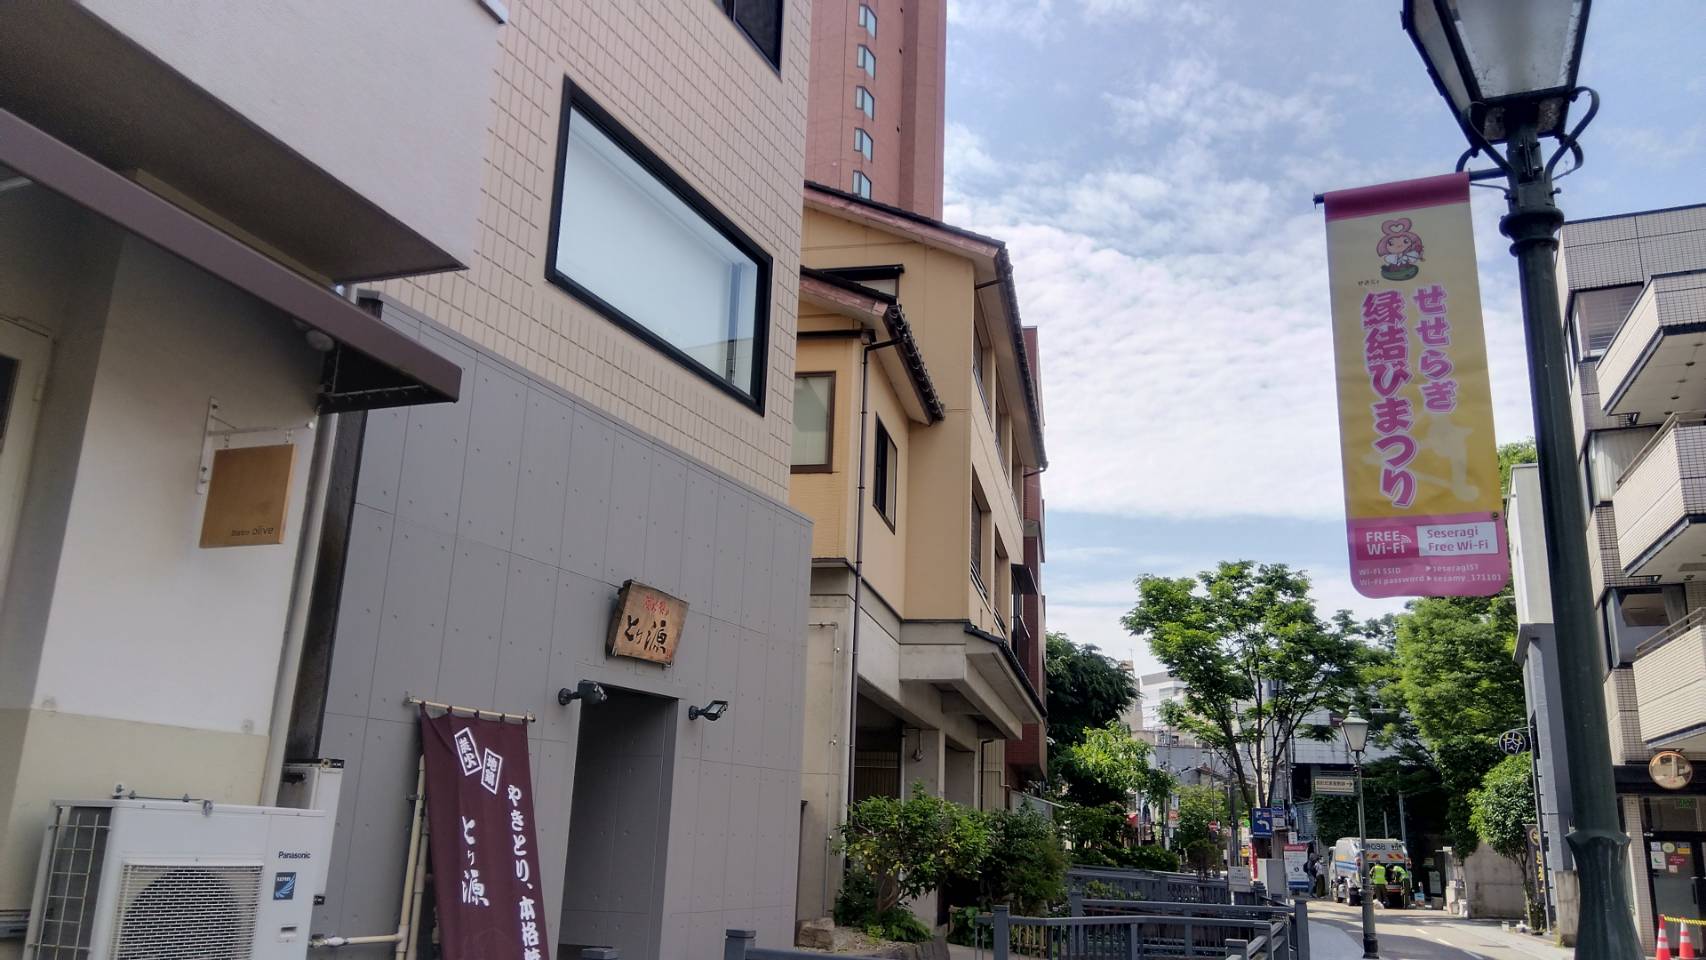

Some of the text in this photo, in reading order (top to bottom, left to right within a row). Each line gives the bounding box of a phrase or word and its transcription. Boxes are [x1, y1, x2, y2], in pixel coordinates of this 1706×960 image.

[1413, 284, 1458, 412] せせらぎ
[1362, 290, 1417, 507] 縁結びまつり
[1366, 530, 1400, 542] FREE
[1427, 526, 1479, 539] Seseragi
[1367, 542, 1405, 555] Wi-Fi
[1428, 539, 1489, 552] Free Wi-Fi
[1382, 567, 1401, 576] SSID
[1383, 576, 1425, 586] password
[278, 851, 311, 859] Panasonic
[461, 815, 490, 907] とり源
